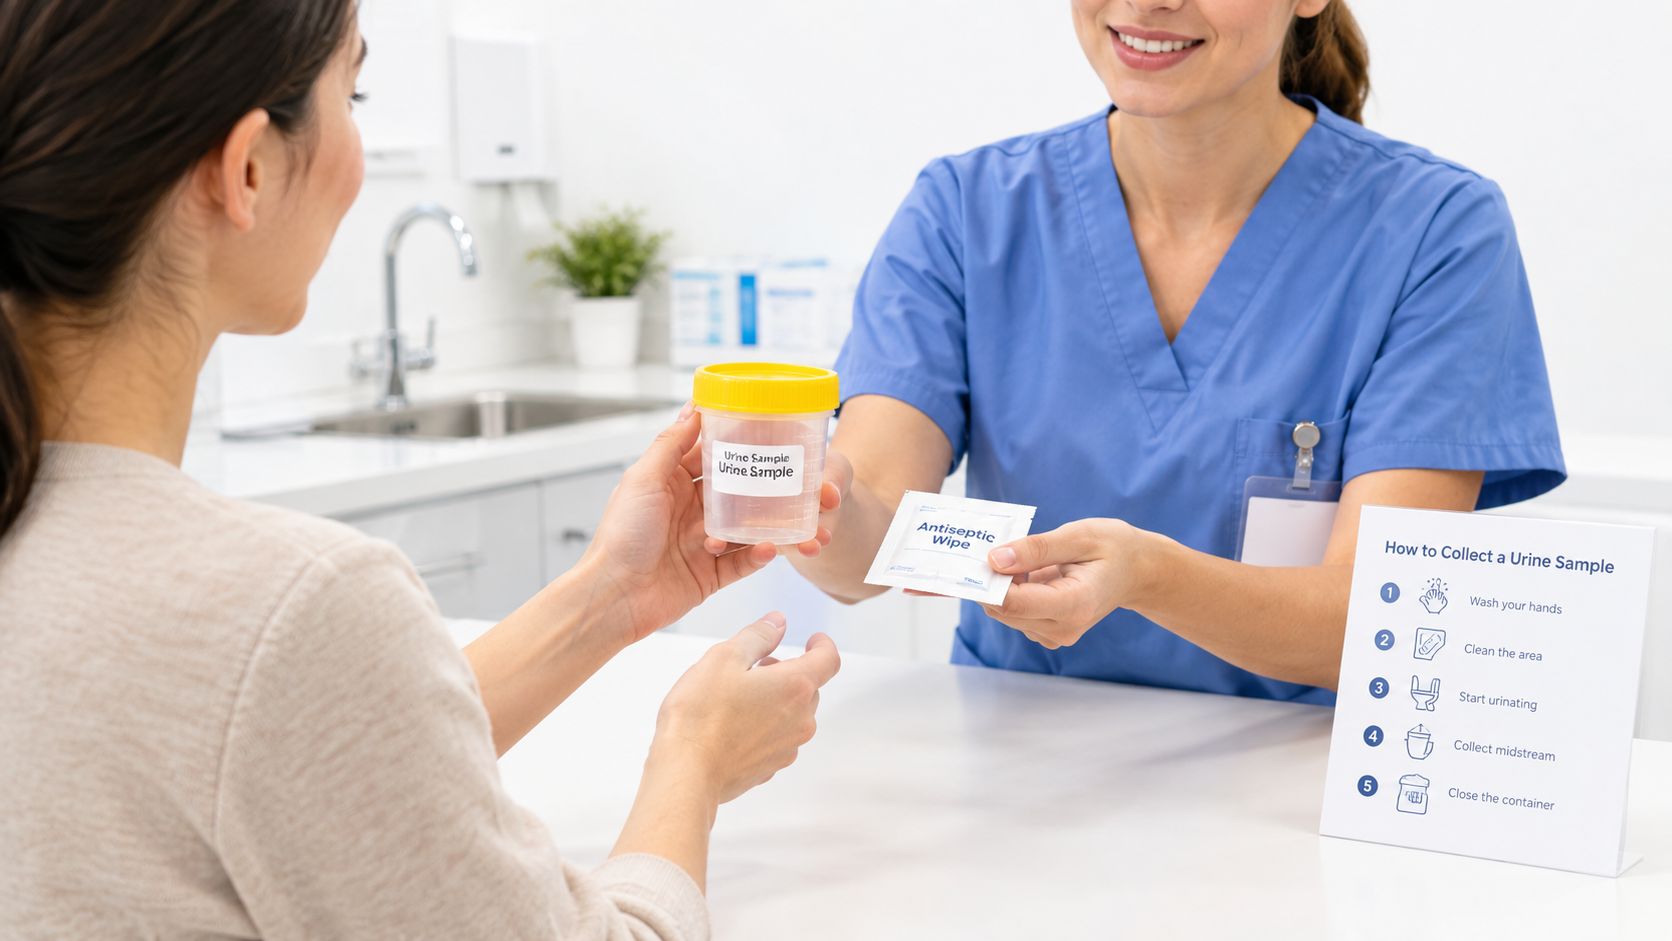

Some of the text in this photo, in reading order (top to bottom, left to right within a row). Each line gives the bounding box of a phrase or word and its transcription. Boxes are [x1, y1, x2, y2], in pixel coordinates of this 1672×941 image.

[719, 461, 793, 480] Urine Sample
[917, 522, 995, 544] Antiseptic
[933, 535, 971, 549] Wipe
[1385, 541, 1614, 575] How to Collect a Urine Sample
[1386, 587, 1562, 614] 1 Wash your hands
[1380, 634, 1542, 661] 2 Clean the area
[1374, 682, 1537, 712] 3 Start urinating
[1368, 730, 1555, 761] 4 Collect midstream
[1363, 779, 1554, 810] 5 Close the container
